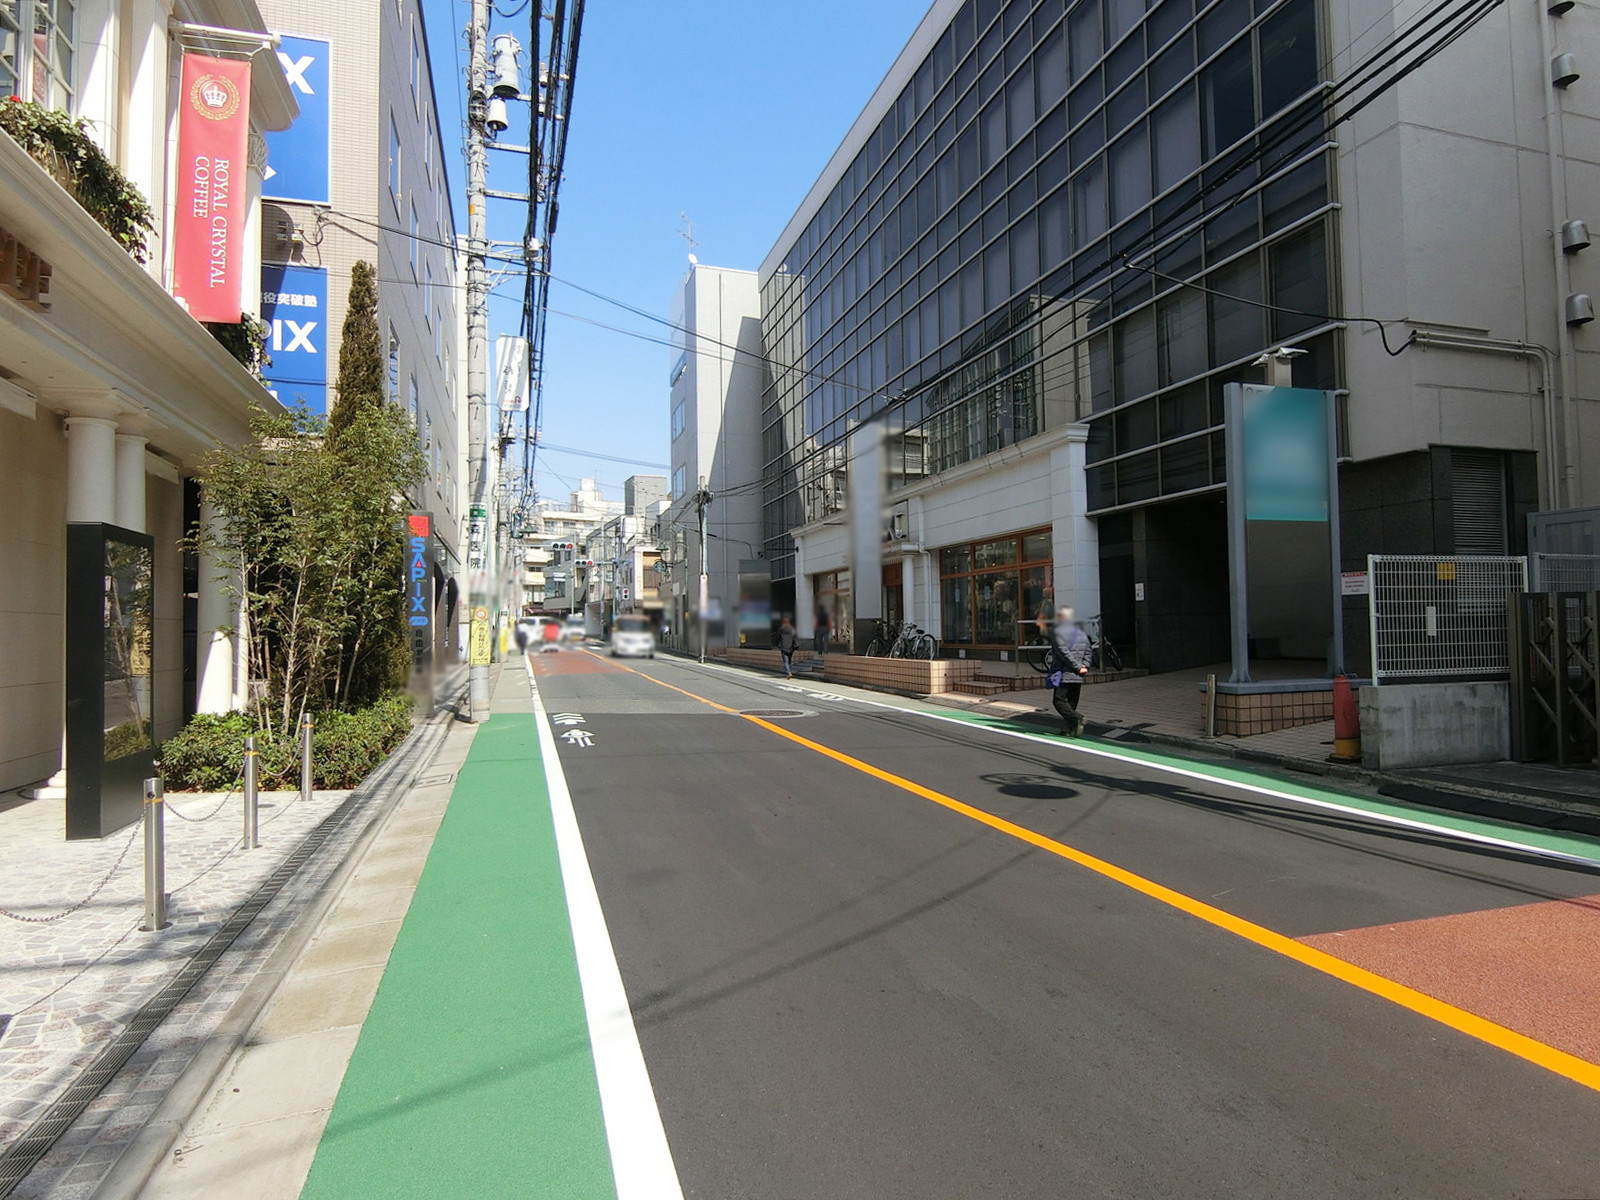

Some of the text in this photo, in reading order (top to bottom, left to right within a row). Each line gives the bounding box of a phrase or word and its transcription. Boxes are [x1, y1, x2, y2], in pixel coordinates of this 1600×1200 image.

[193, 156, 210, 218] COFFEE
[210, 158, 230, 288] ROYAL CRYSTAL
[261, 292, 318, 308] 役突破塾
[410, 537, 427, 612] SAPIX
